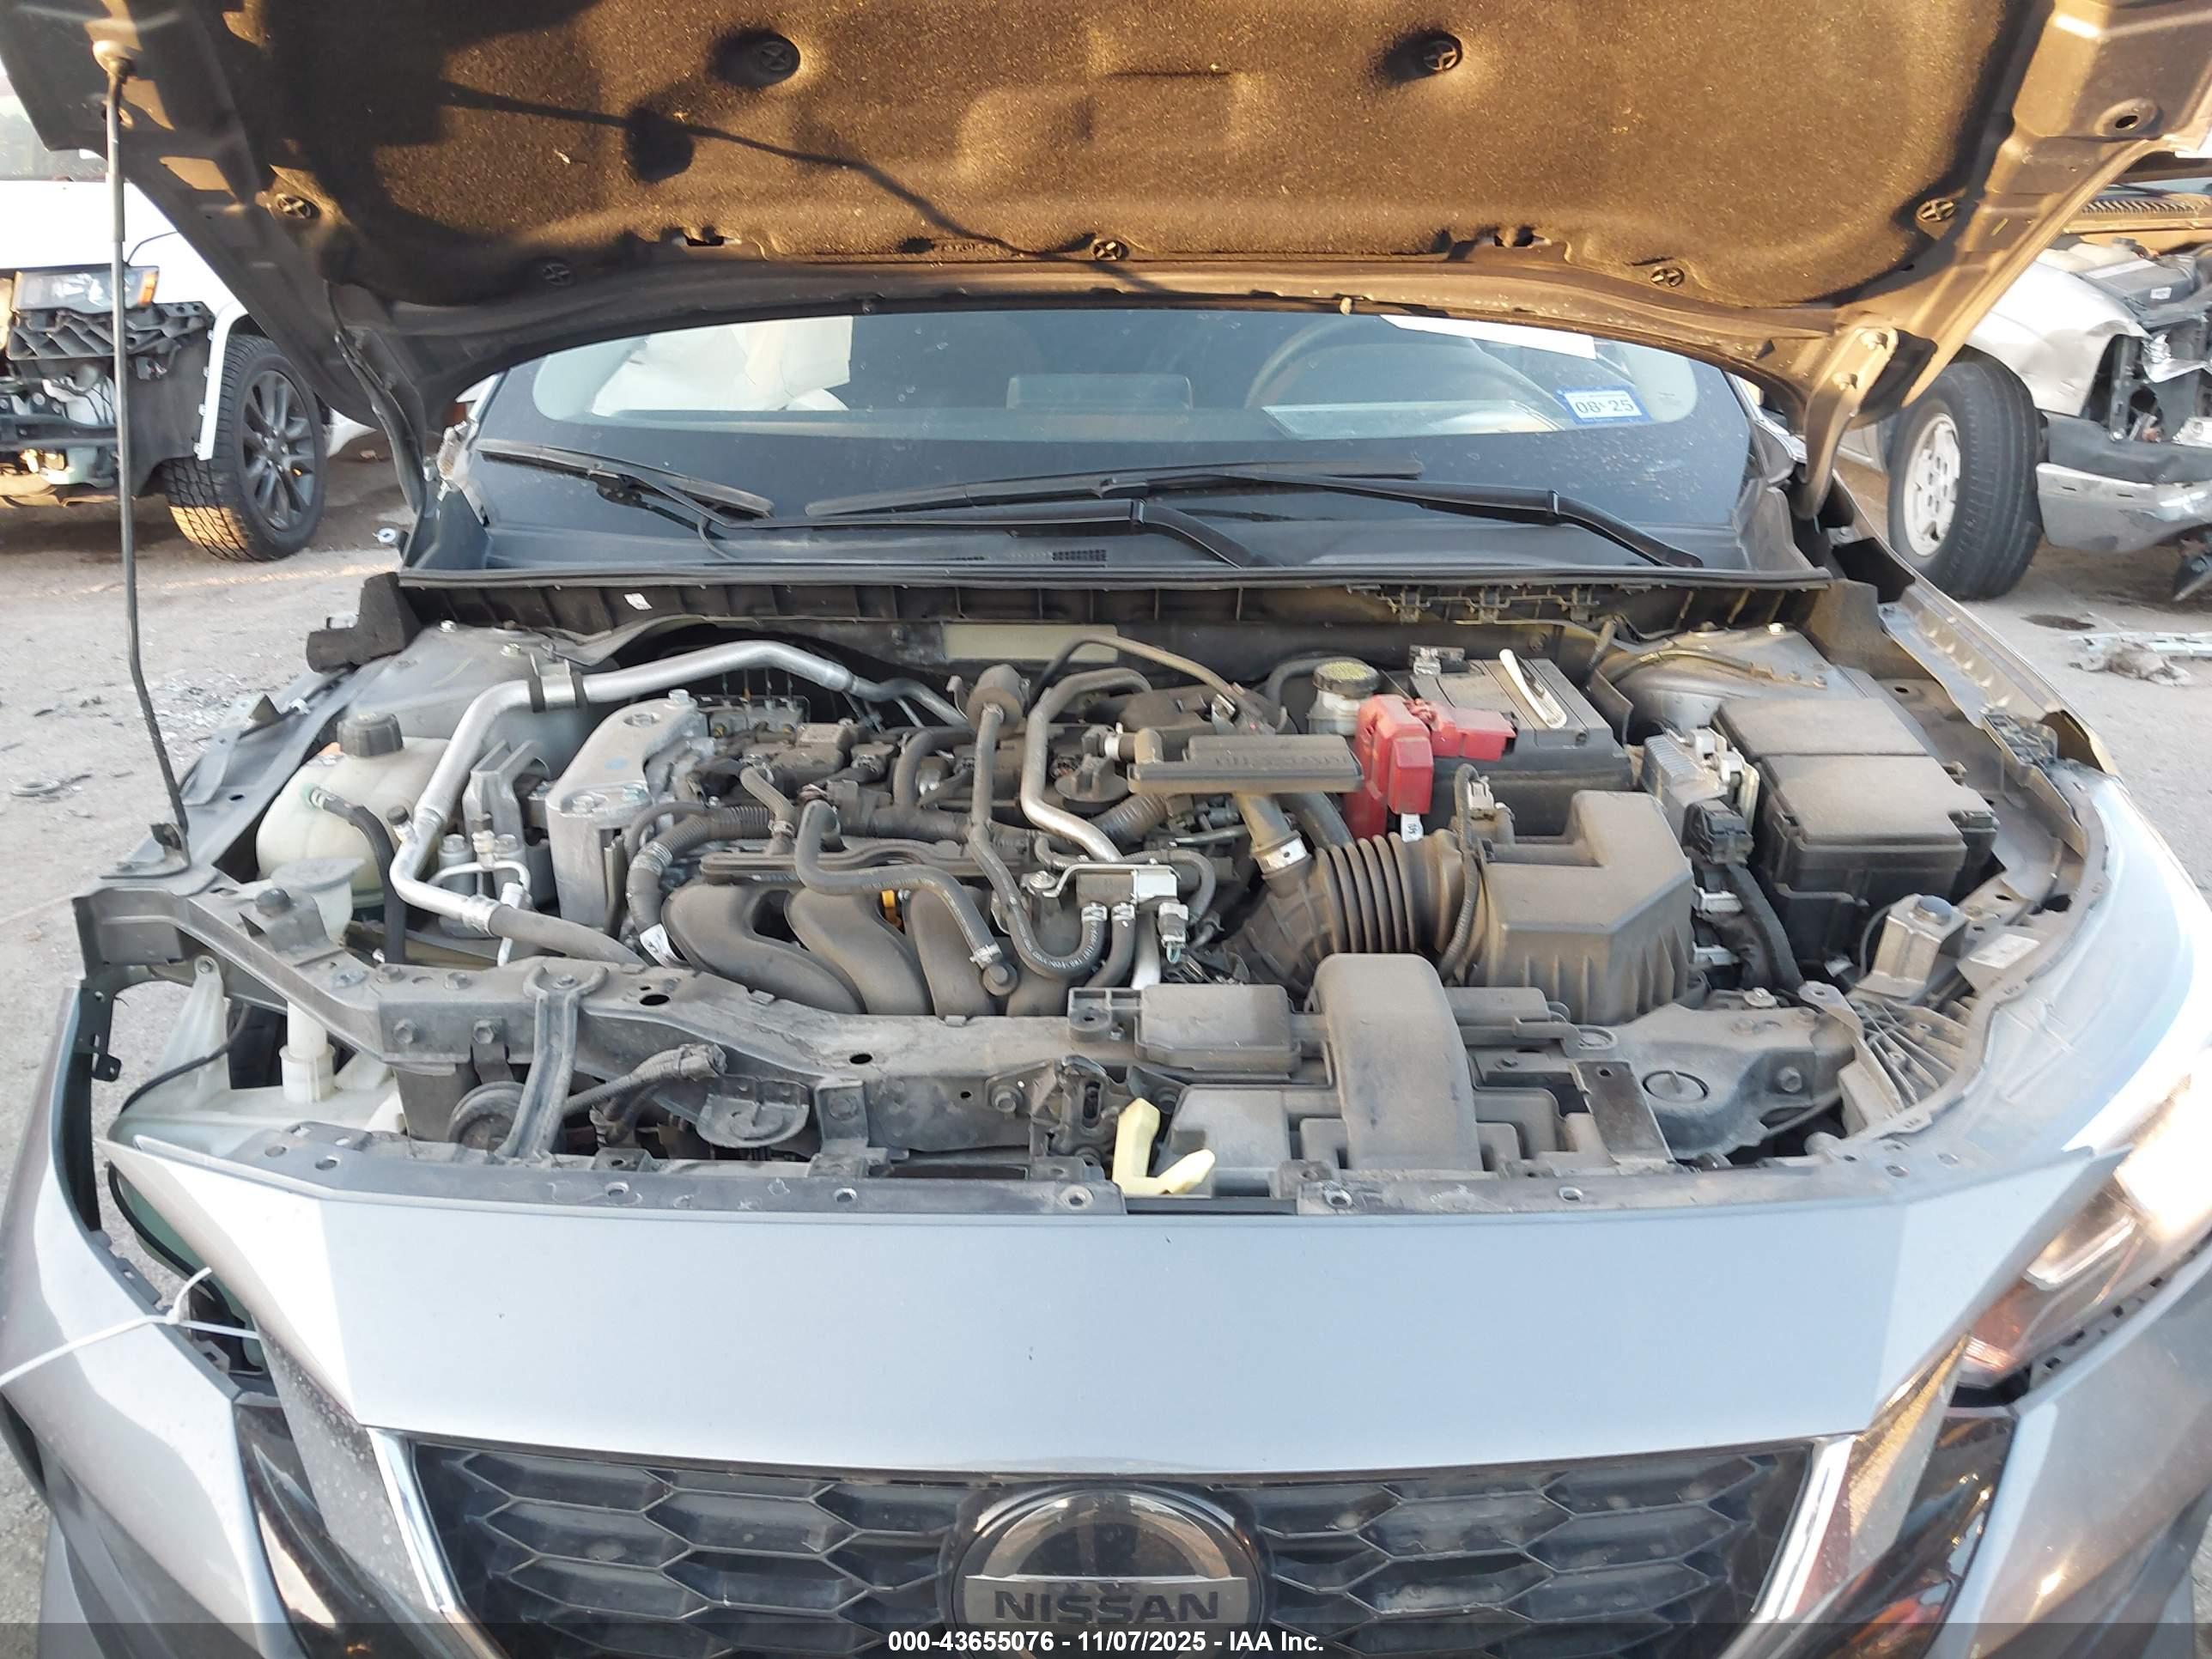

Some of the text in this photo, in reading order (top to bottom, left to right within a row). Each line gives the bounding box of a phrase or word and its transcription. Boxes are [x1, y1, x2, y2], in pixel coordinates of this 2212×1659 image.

[1575, 398, 1634, 414] 08 25
[995, 1590, 1218, 1623] NISSAN
